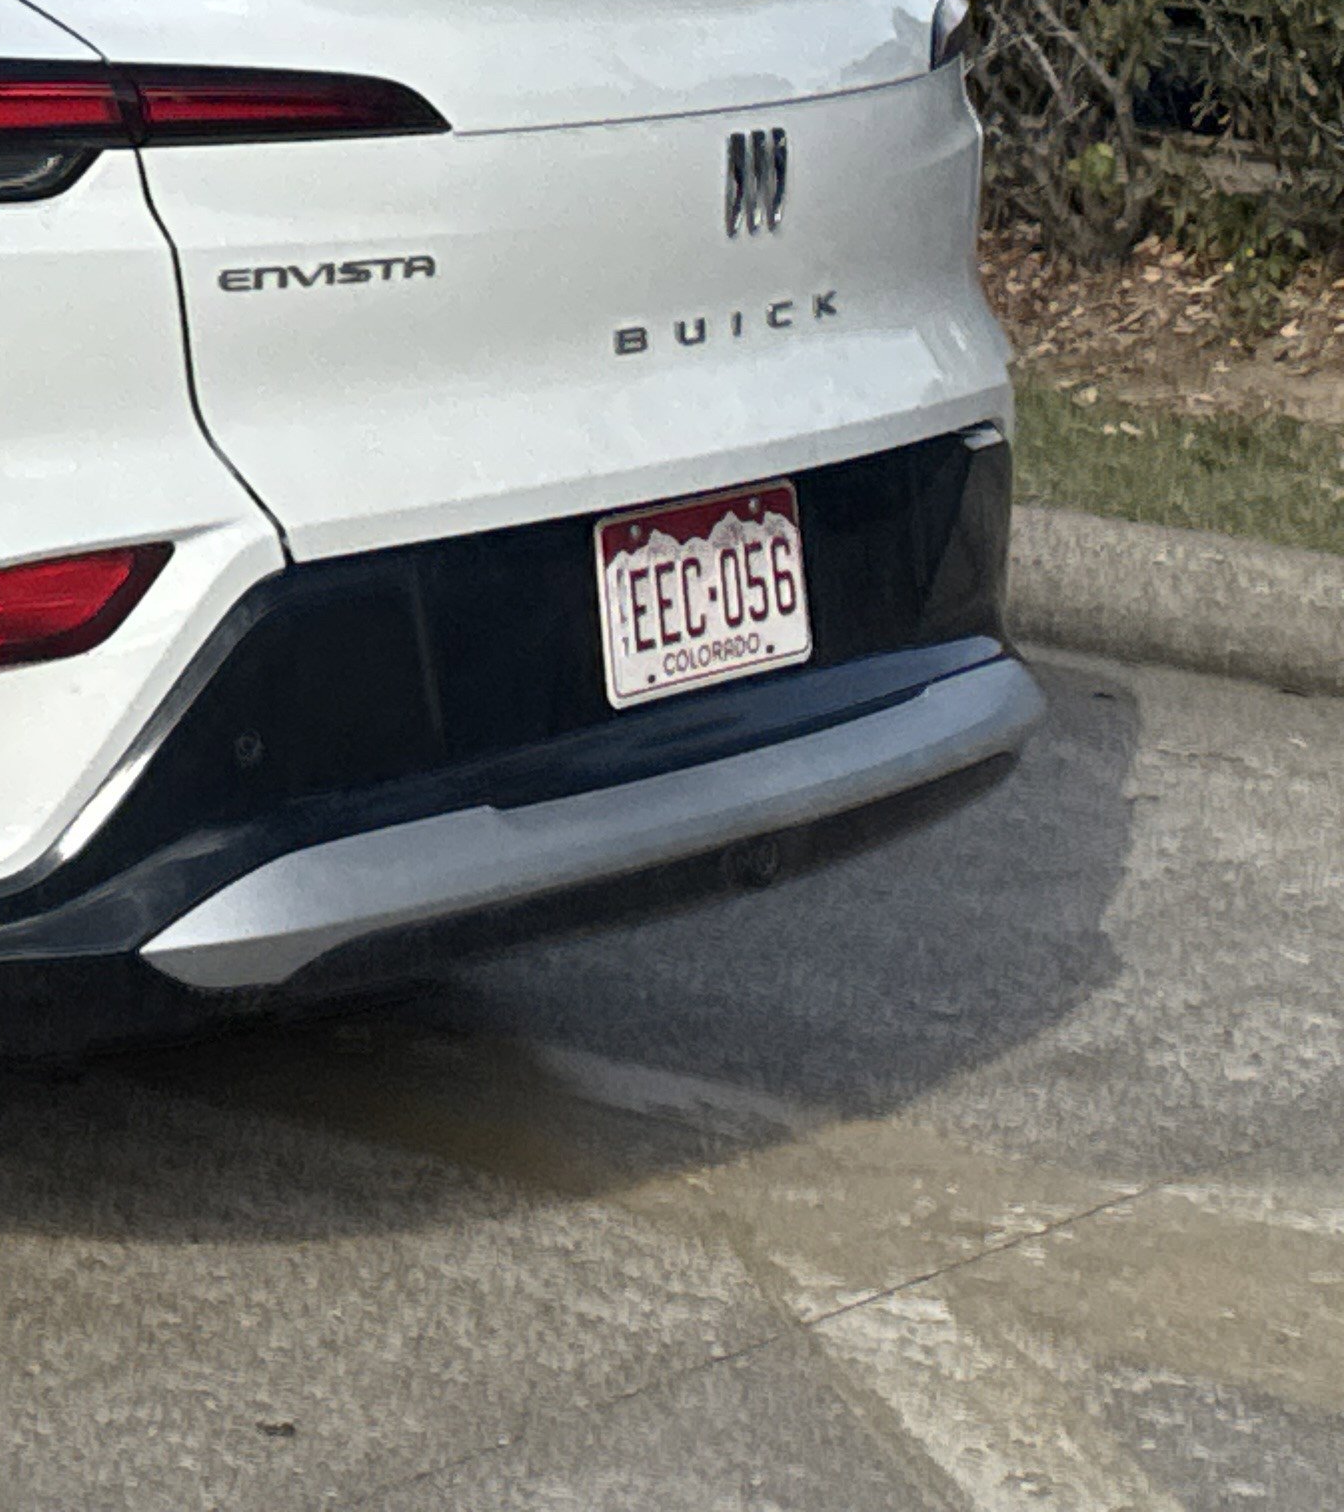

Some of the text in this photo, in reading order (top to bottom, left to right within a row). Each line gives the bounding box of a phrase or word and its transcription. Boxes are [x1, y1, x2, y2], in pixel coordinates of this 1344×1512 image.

[218, 255, 436, 292] ENVISTA
[613, 290, 838, 355] BUICK
[662, 632, 761, 677] COLORADO
